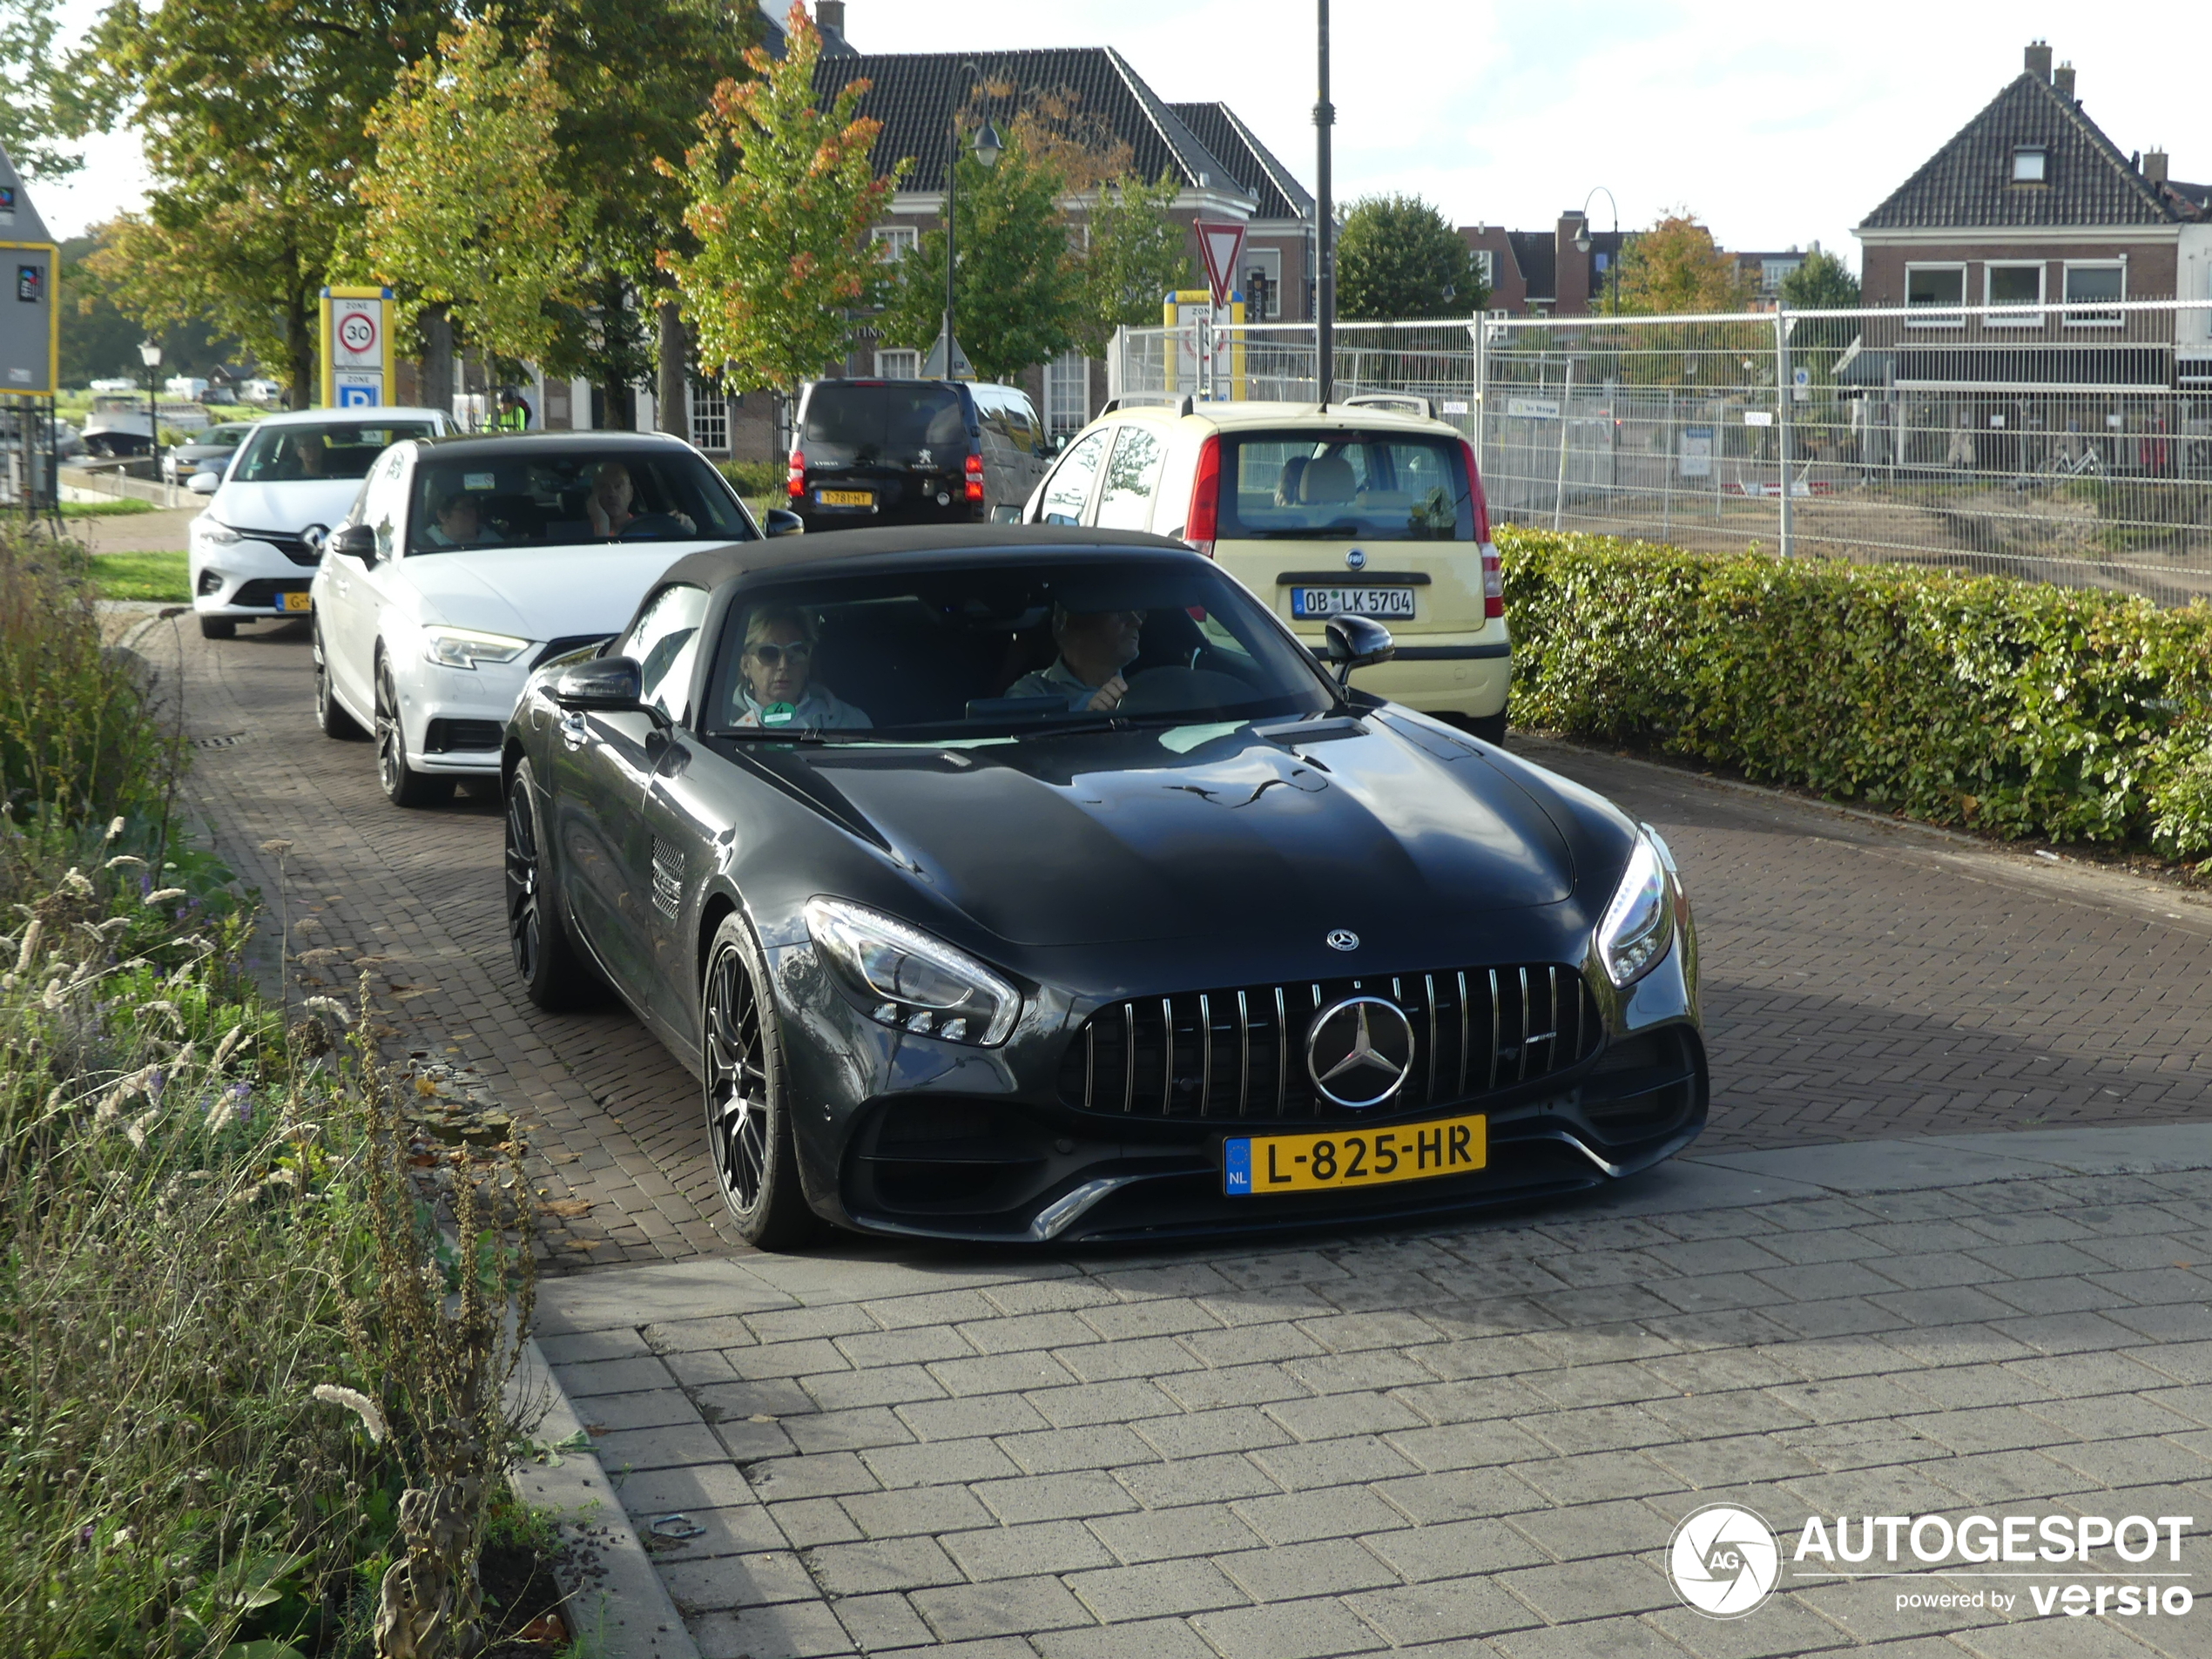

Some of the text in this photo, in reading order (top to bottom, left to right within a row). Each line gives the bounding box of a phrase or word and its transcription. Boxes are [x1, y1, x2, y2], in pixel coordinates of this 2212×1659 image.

[346, 326, 369, 341] 30
[1306, 591, 1411, 611] OB LK 5704
[1267, 1124, 1473, 1184] L-825-HR
[1229, 1172, 1248, 1184] NL
